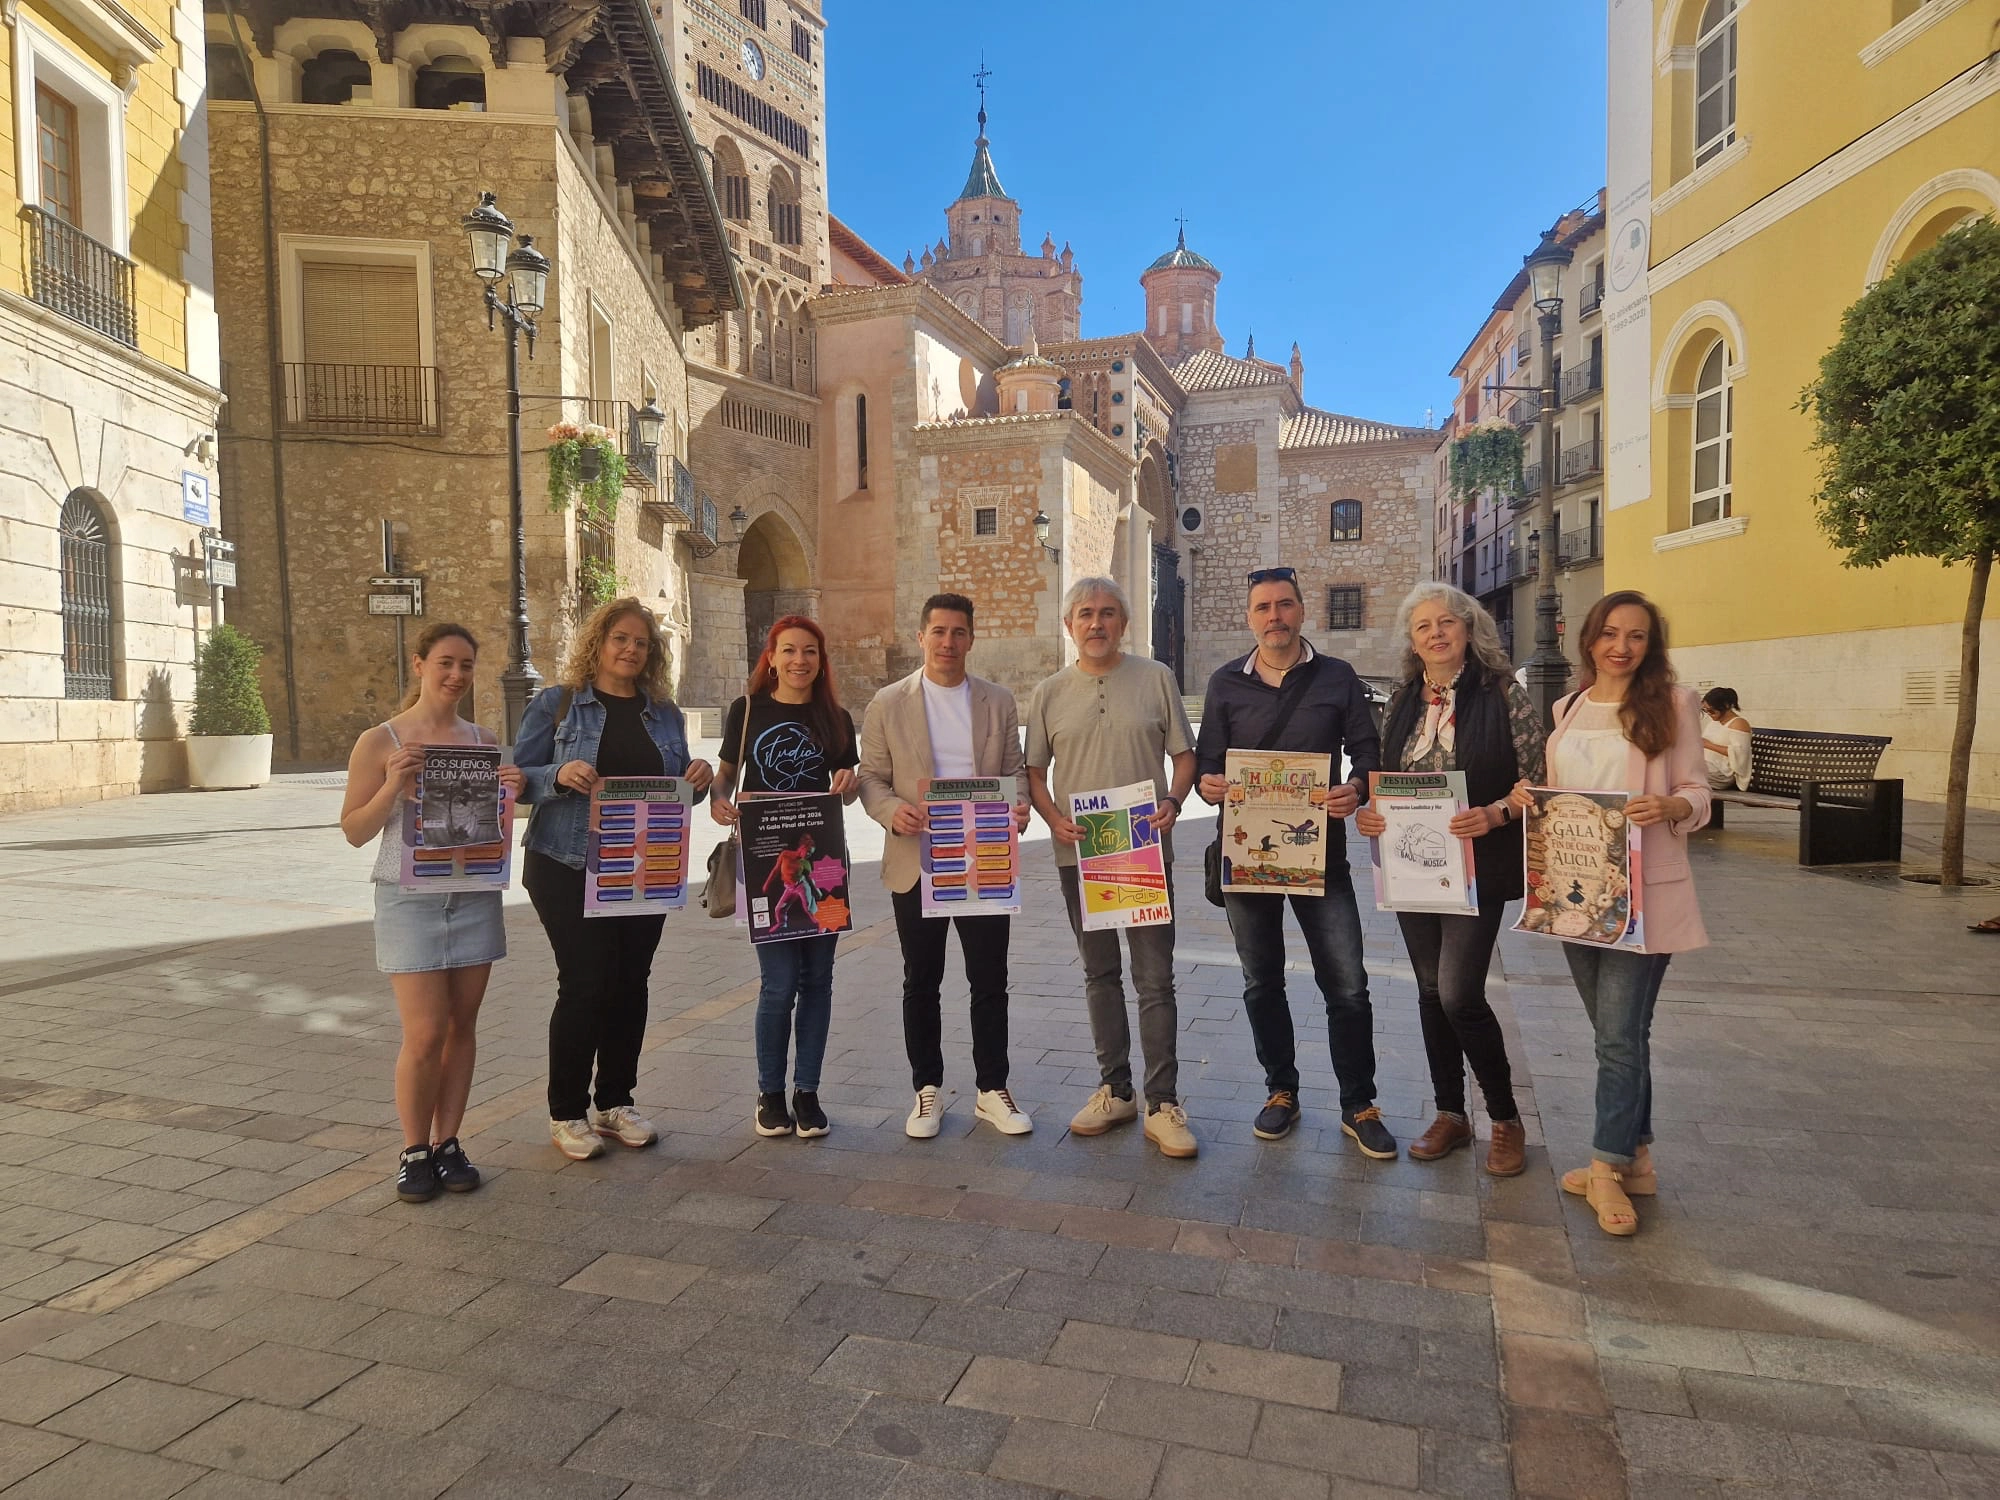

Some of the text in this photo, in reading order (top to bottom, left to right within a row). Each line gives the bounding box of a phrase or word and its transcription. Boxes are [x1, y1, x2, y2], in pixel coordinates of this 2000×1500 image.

[426, 758, 491, 769] LOS SUEÑOS
[425, 770, 497, 781] DE UN AVATAR
[1249, 770, 1309, 786] MÚSICA
[1384, 776, 1441, 785] FESTIVALES
[611, 780, 671, 790] FESTIVALES
[936, 780, 994, 790] FESTIVALES
[1074, 795, 1109, 813] ALMA
[779, 814, 797, 822] mayo
[1553, 820, 1594, 839] GALA
[1552, 838, 1565, 849] FIN
[1566, 840, 1574, 850] DE
[1576, 841, 1601, 853] CURSO
[1552, 850, 1598, 868] ALICIA
